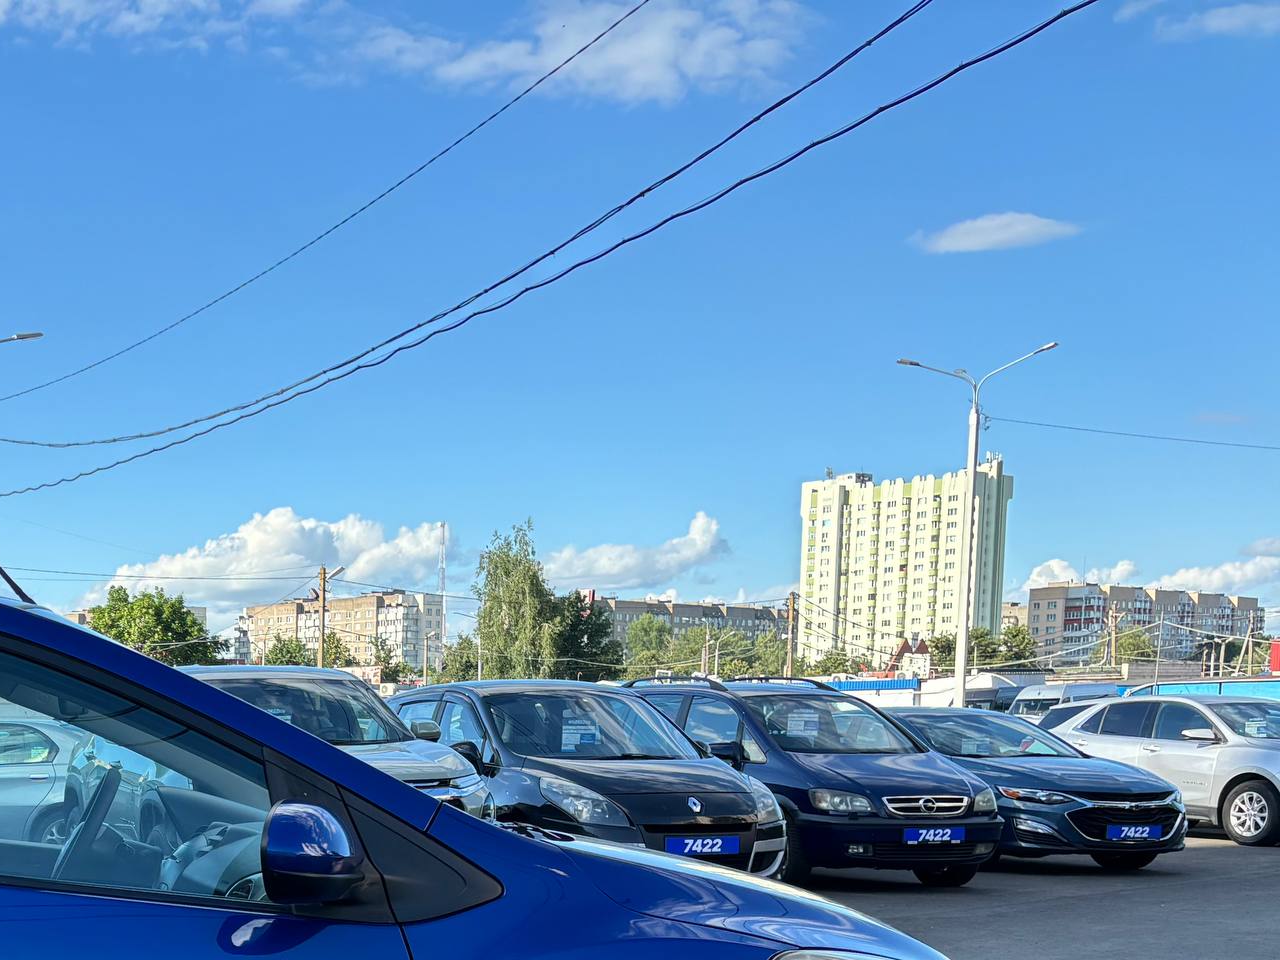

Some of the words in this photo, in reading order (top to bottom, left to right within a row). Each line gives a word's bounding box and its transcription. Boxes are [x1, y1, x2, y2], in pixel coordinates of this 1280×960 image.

[918, 828, 951, 842] 7422
[1120, 826, 1150, 838] 7422
[683, 838, 723, 853] 7422
